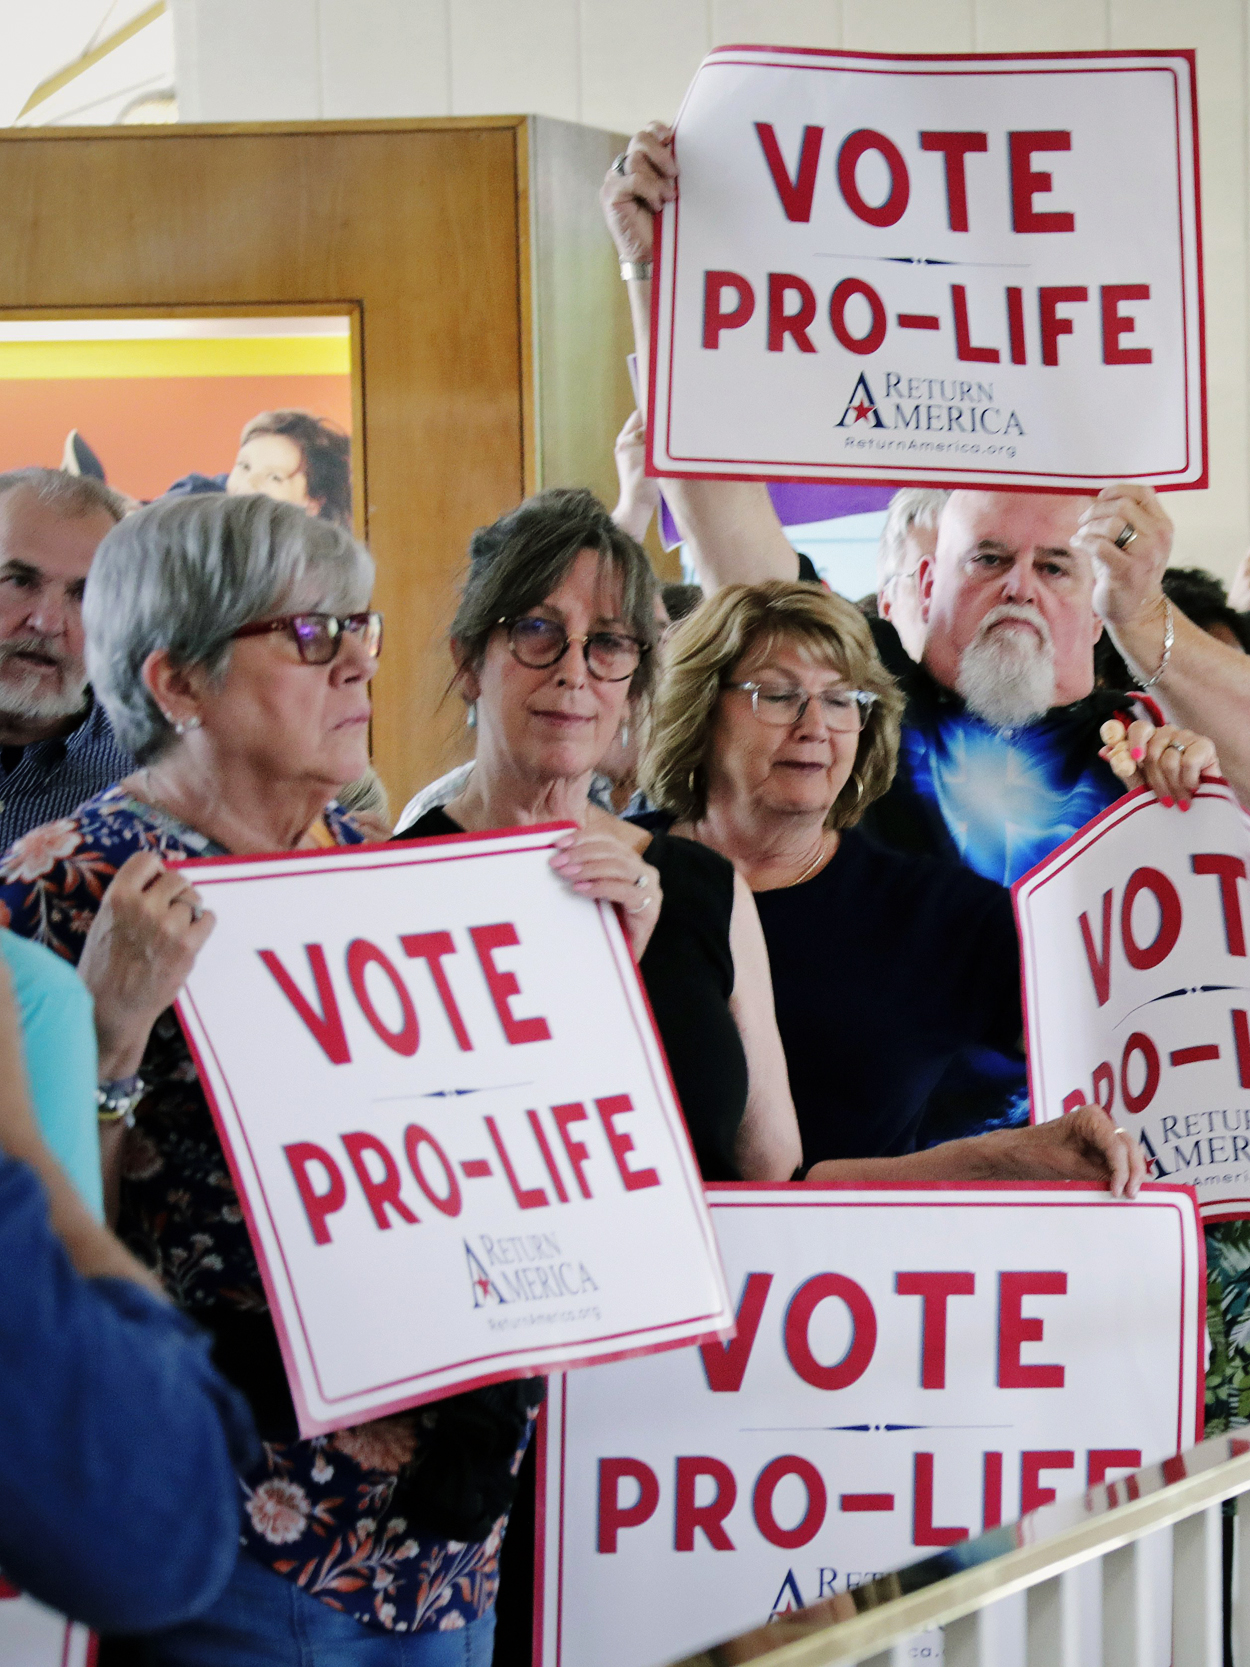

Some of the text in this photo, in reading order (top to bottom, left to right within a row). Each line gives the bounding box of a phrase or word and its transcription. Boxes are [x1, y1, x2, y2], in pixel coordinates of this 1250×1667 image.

[754, 122, 1076, 233] VOTE
[702, 271, 1153, 366] PRO-LIFE
[834, 370, 1027, 438] AMERICA
[884, 371, 995, 403] RETURN
[844, 436, 1018, 459] ReturnAmerica.org
[257, 922, 553, 1066] VOTE
[282, 1094, 661, 1246] PRO-LIFE
[463, 1236, 599, 1310] AMERICA
[479, 1233, 562, 1267] RETURN
[699, 1271, 1068, 1393] VOTE
